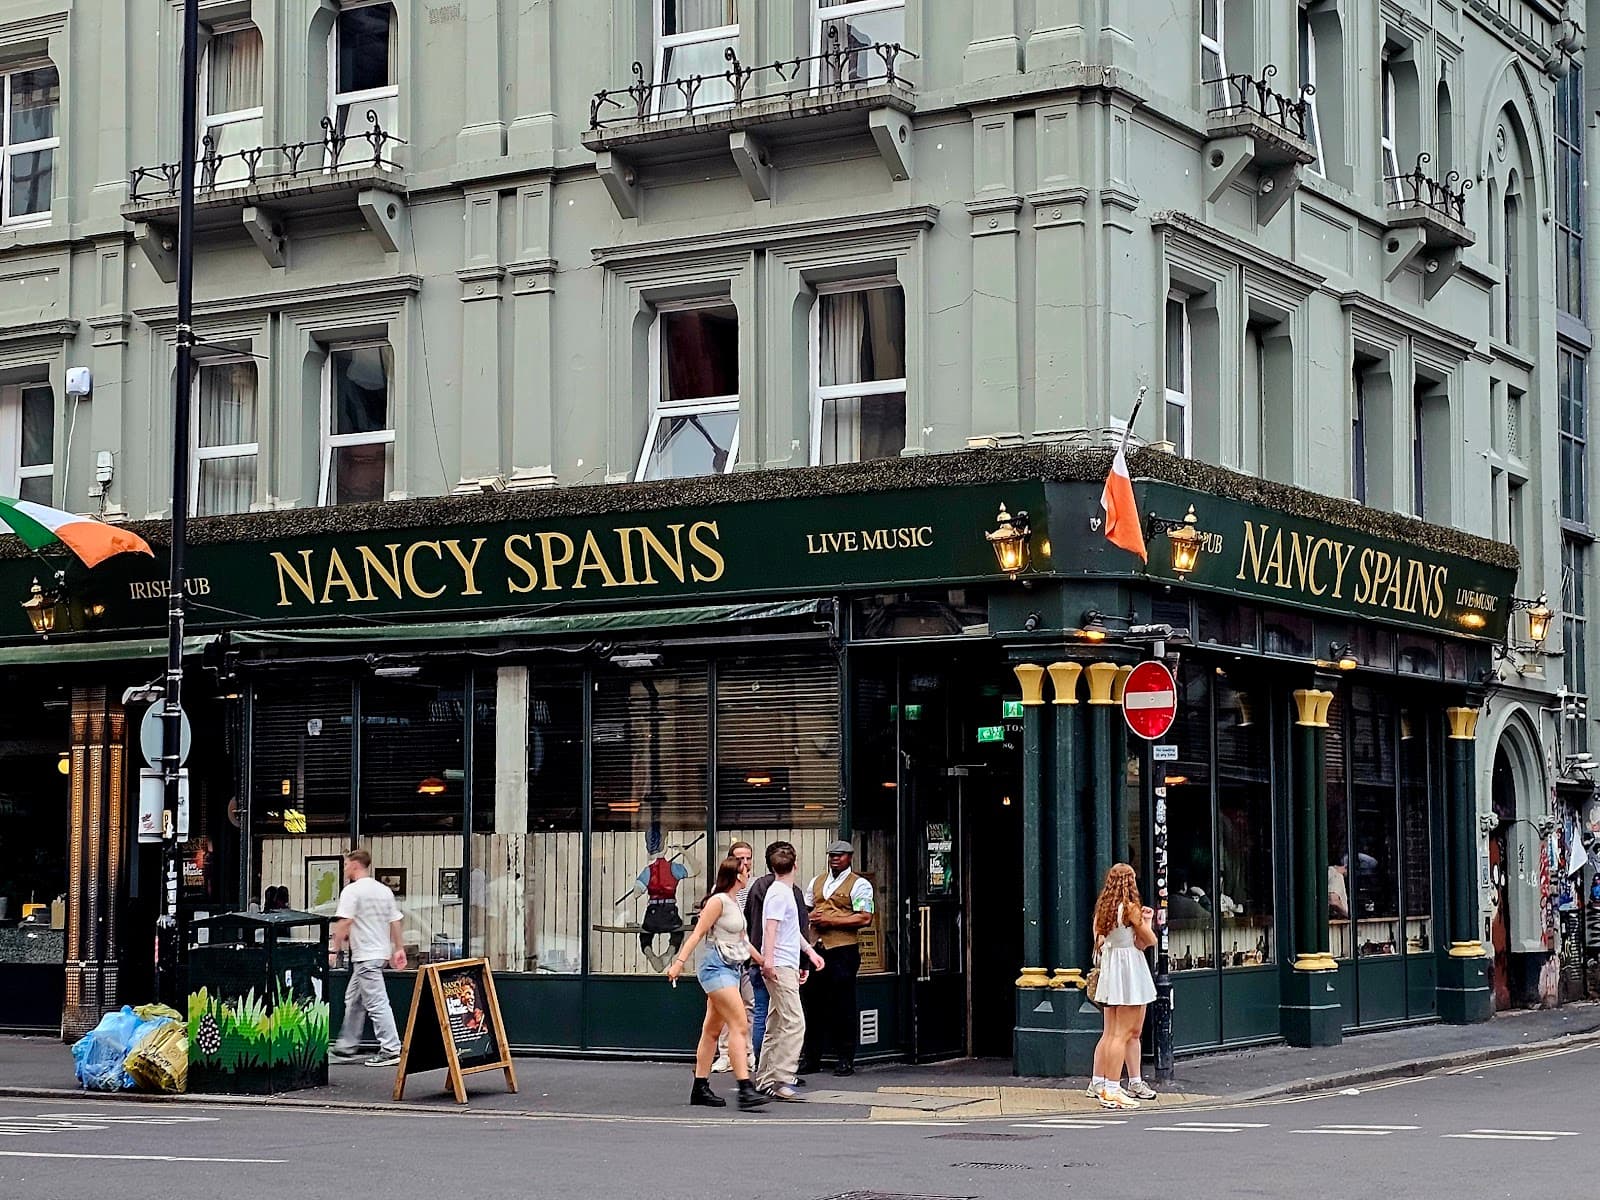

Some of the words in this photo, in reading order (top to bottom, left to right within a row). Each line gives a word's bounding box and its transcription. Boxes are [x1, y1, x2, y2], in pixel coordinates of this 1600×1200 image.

[806, 531, 859, 554] LIVE
[861, 526, 934, 550] MUSIC
[1202, 533, 1223, 554] PUB
[270, 538, 487, 606] NANCY
[504, 520, 725, 593] SPAINS
[1236, 520, 1355, 598] NANCY
[1354, 548, 1448, 618] SPAINS
[129, 580, 172, 599] IRISH
[184, 578, 210, 596] UB
[1456, 588, 1475, 606] LIVE
[1474, 592, 1498, 612] MUSIC
